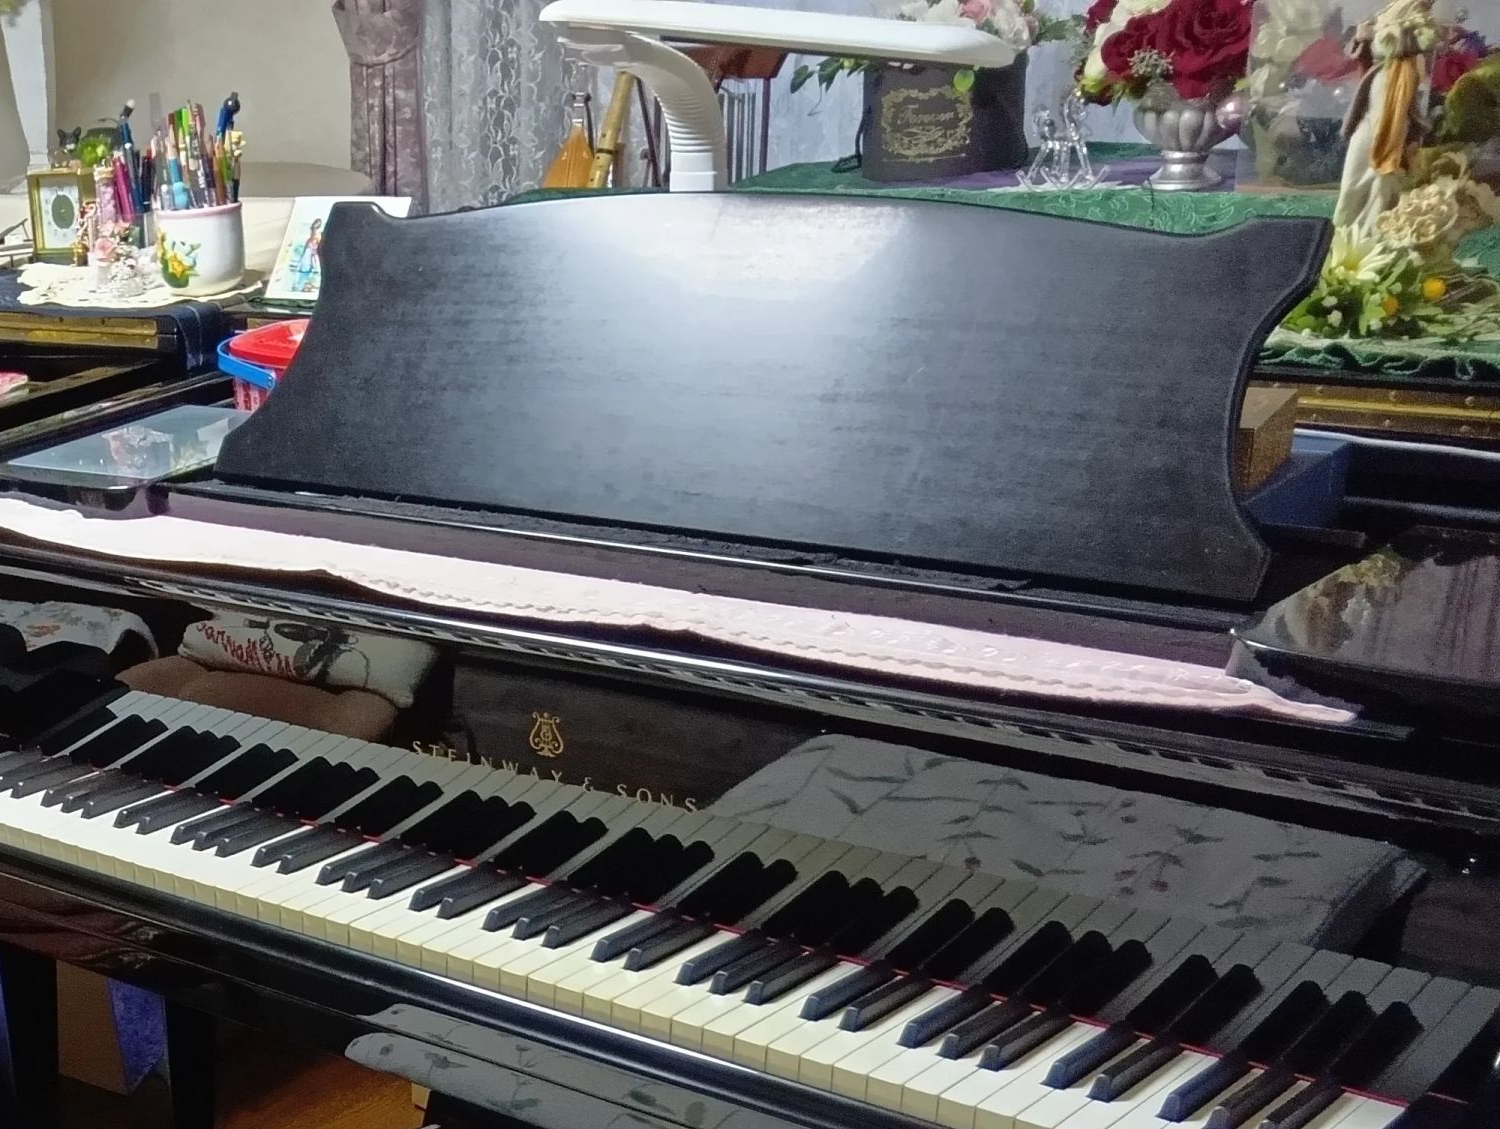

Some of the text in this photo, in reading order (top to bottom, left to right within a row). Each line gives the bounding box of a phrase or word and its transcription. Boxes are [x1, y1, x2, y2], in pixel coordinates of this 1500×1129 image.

[412, 740, 699, 814] STEINWAY & SONS
